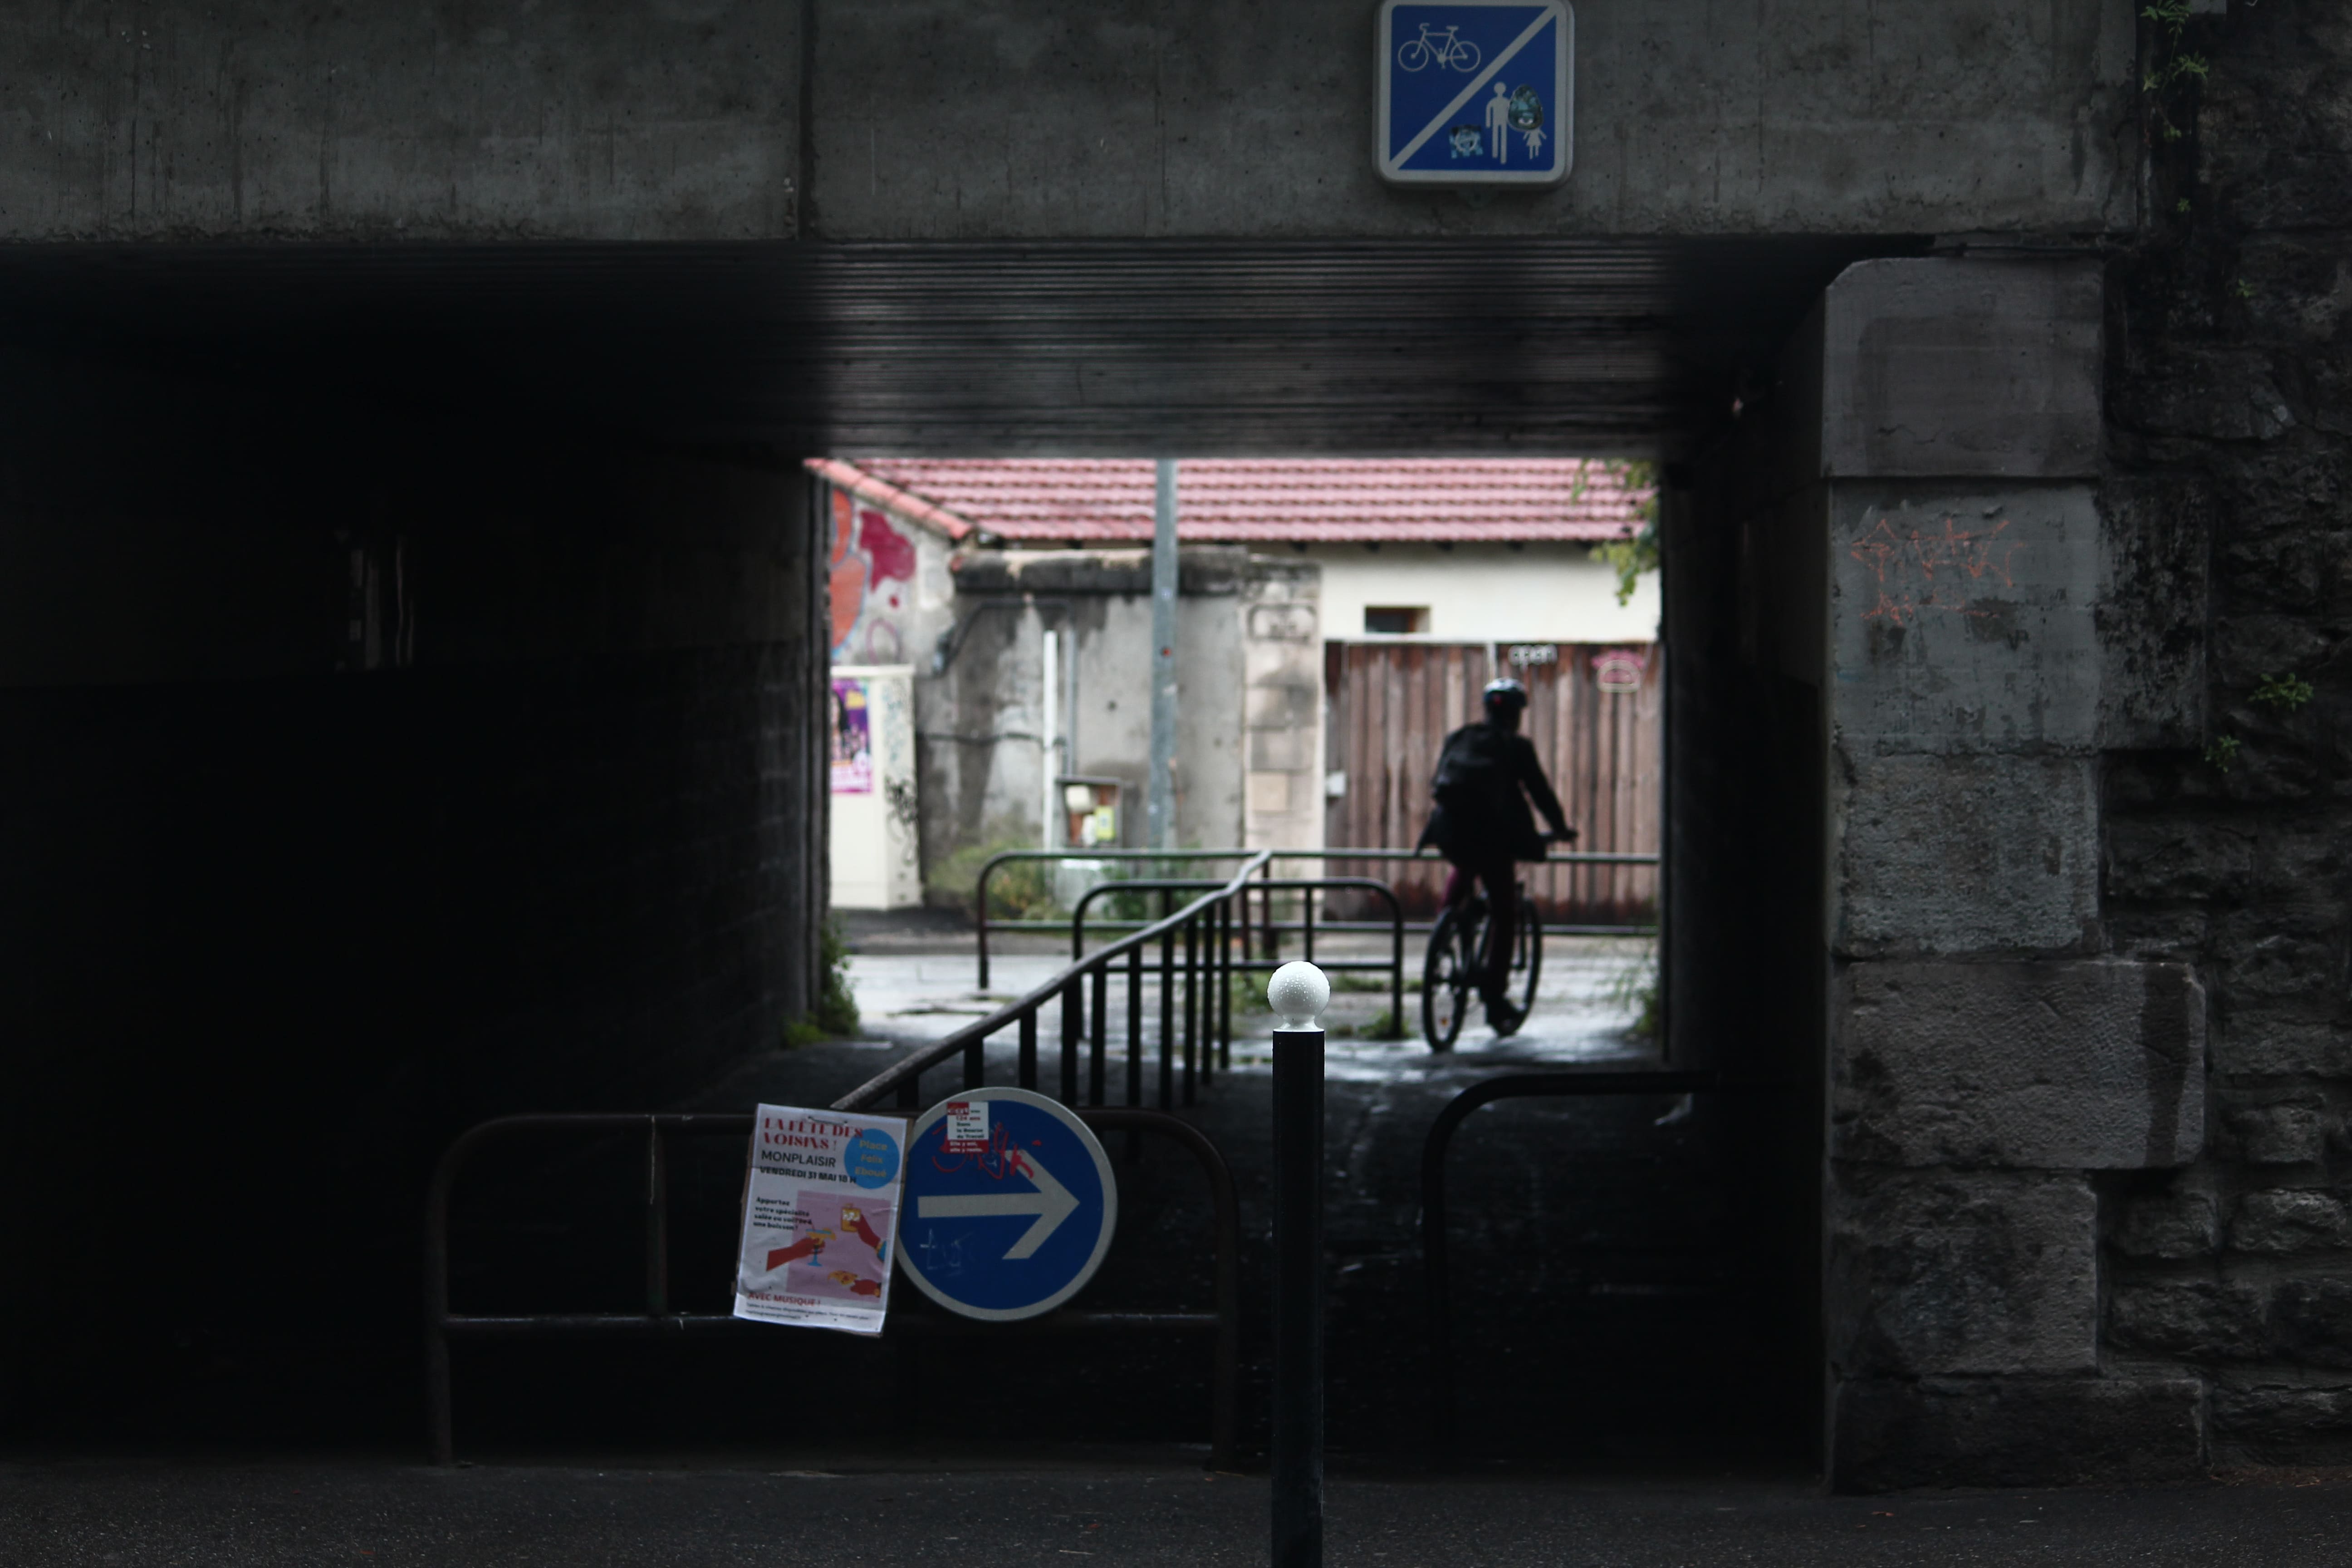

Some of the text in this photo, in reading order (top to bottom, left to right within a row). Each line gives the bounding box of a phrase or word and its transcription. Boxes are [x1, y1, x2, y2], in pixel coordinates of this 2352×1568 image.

[765, 1117, 784, 1130] LA
[833, 1124, 863, 1138] DES
[764, 1132, 829, 1149] VOISINS
[859, 1139, 888, 1151] Place
[761, 1150, 836, 1168] MONPLAISIR
[760, 1166, 806, 1178] VENDREDI
[808, 1171, 817, 1179] 31
[819, 1172, 836, 1181] MAI
[756, 1196, 790, 1205] Apportez
[768, 1222, 794, 1231] boisson
[749, 1292, 771, 1301] AVEC
[774, 1294, 816, 1306] MUSIQUE
